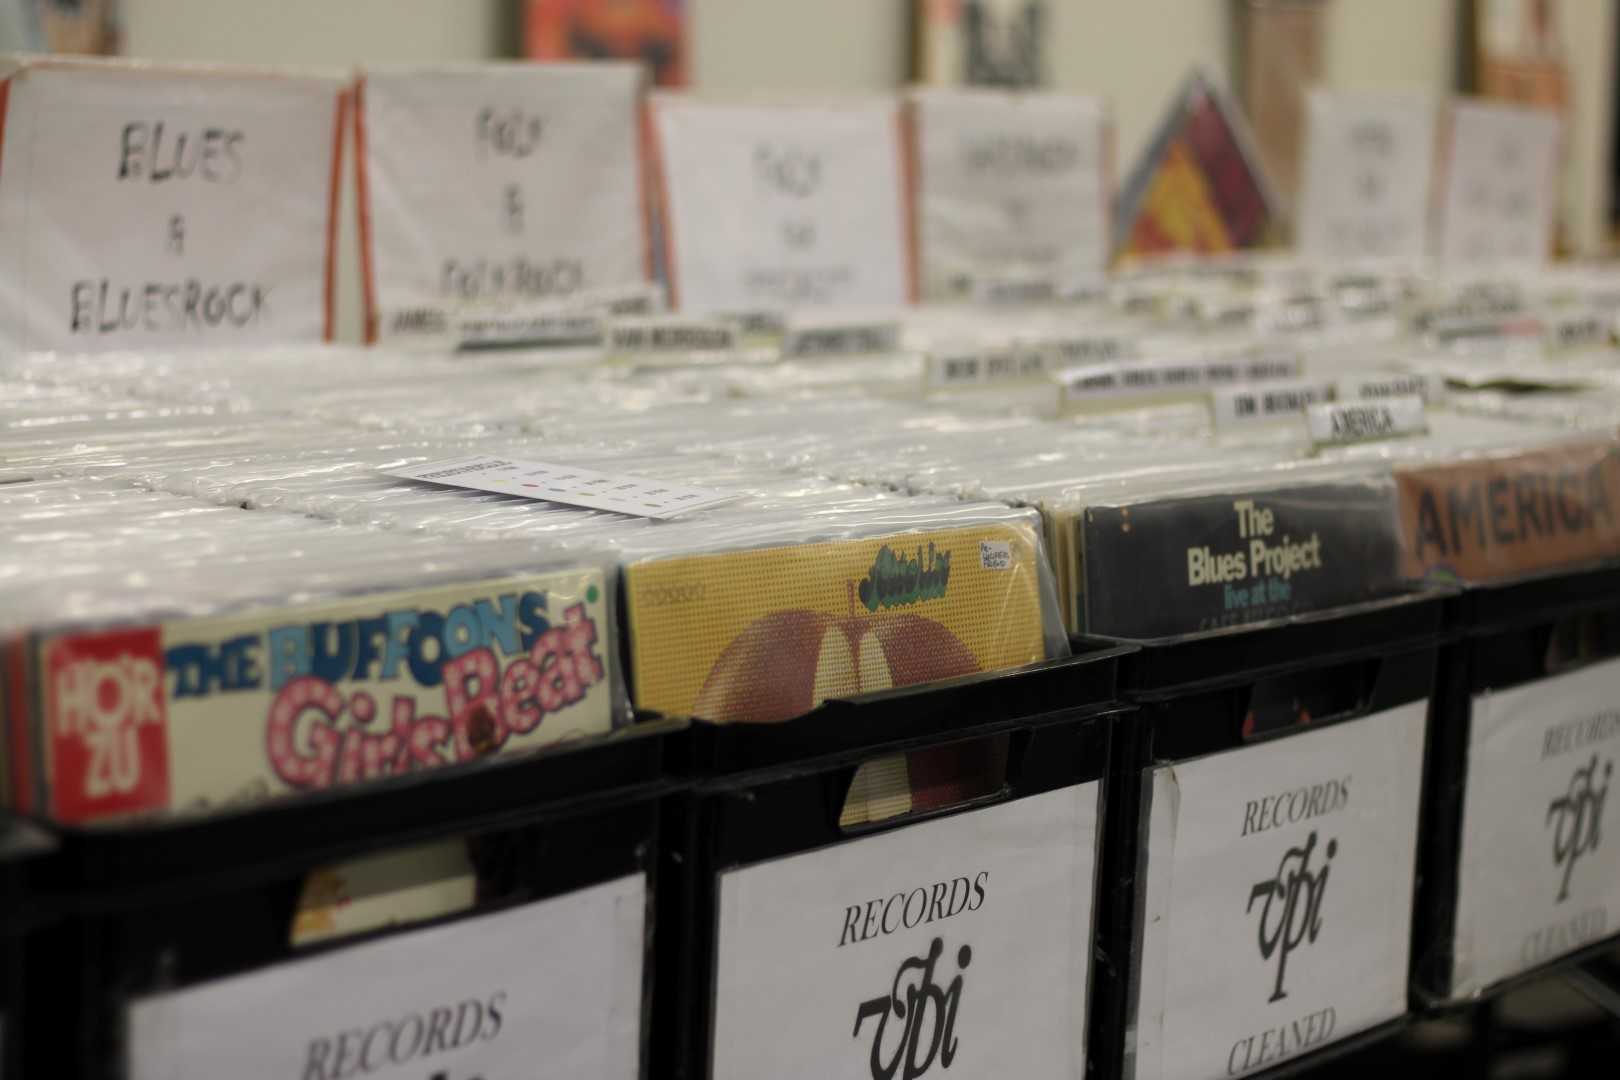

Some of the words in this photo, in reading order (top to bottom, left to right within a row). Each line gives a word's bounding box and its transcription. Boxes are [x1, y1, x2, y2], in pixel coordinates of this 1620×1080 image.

[116, 118, 247, 184] BLUES
[1331, 404, 1394, 438] AMERICA
[1233, 499, 1274, 539] The
[1415, 462, 1614, 560] AMERICA
[1187, 546, 1248, 586] Blues
[1249, 531, 1322, 580] Project
[165, 633, 262, 700] THE
[268, 591, 551, 692] BUFFOONS
[1240, 776, 1351, 837] RECORDS
[838, 872, 989, 946] RECORDS
[302, 990, 507, 1080] RECORDS
[1227, 1006, 1336, 1076] CLEANED
